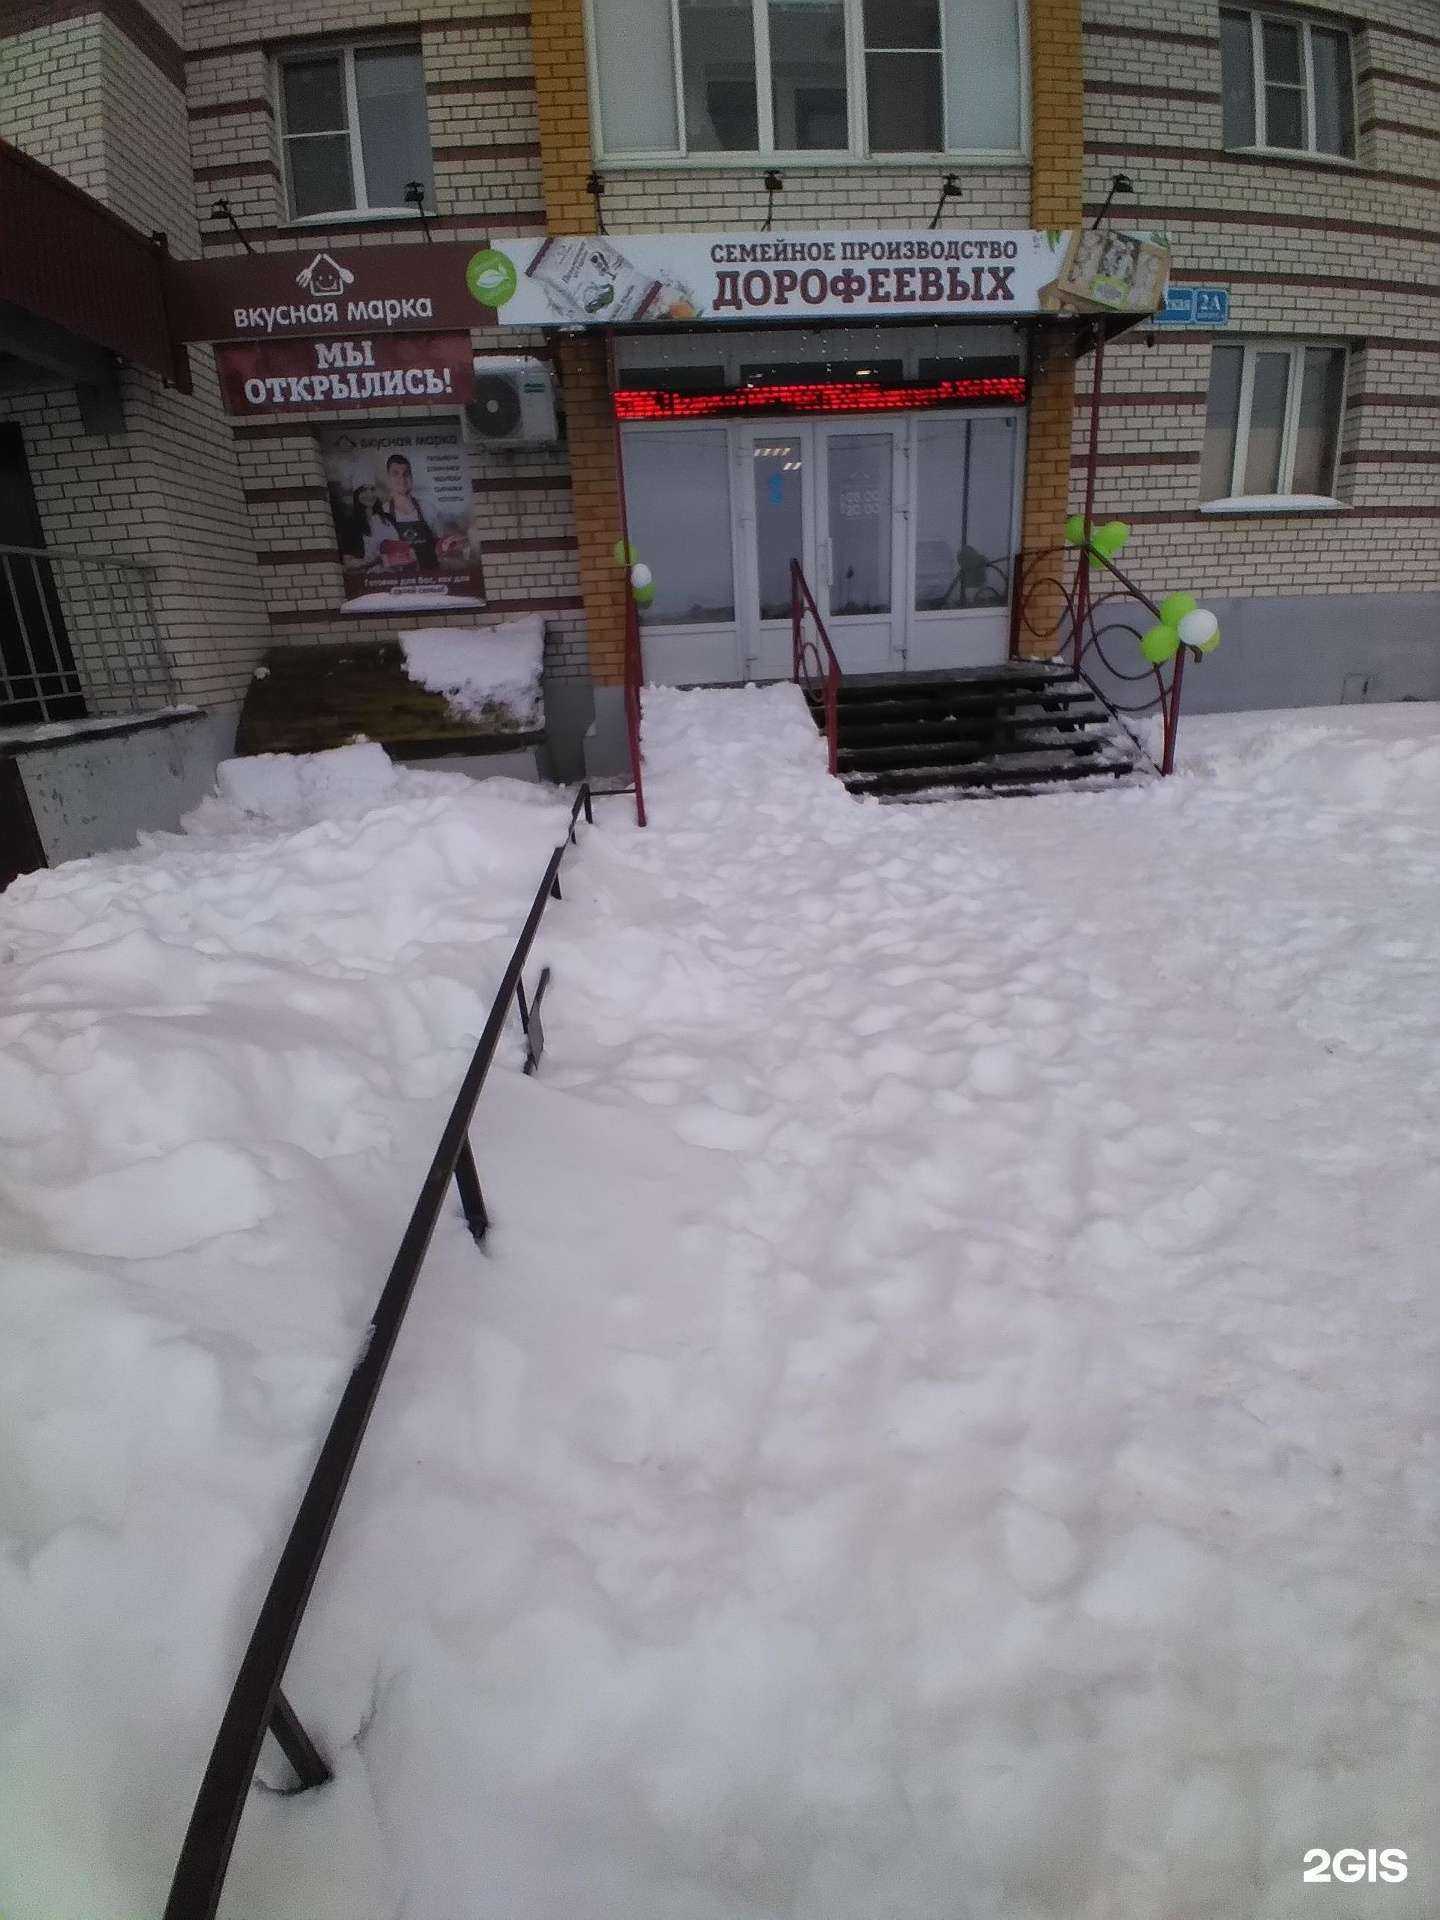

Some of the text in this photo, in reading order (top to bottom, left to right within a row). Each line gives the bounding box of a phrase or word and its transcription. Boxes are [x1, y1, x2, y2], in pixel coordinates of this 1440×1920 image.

[710, 238, 836, 263] СЕМЕЙНОЕ
[840, 239, 1018, 262] ПРОИЗВОДСТВО
[712, 266, 1016, 311] ДОРОФЕЕВЫХ
[234, 298, 433, 332] вкусная марка
[315, 340, 375, 369] МЫ
[244, 367, 453, 404] ОТКРЫЛИСЬ!
